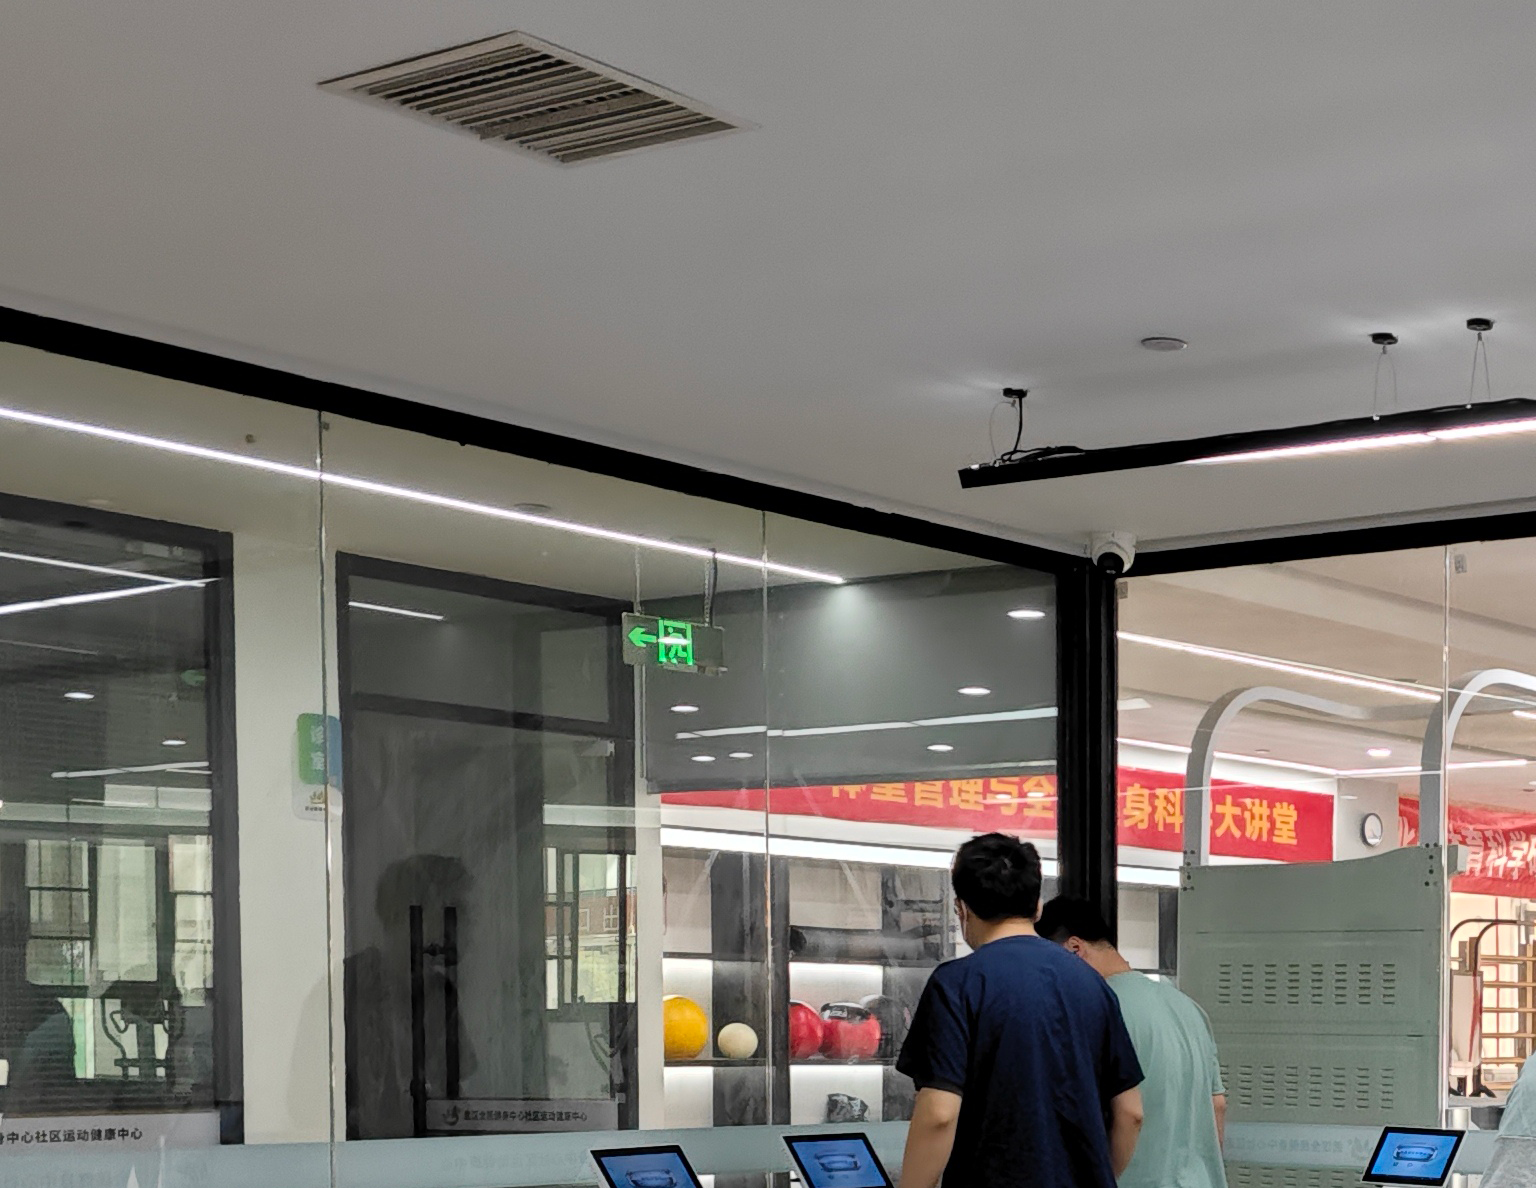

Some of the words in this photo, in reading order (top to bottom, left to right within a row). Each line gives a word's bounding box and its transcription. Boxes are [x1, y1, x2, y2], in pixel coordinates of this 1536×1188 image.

[0, 1127, 143, 1145] 中心社区运动健康中心
